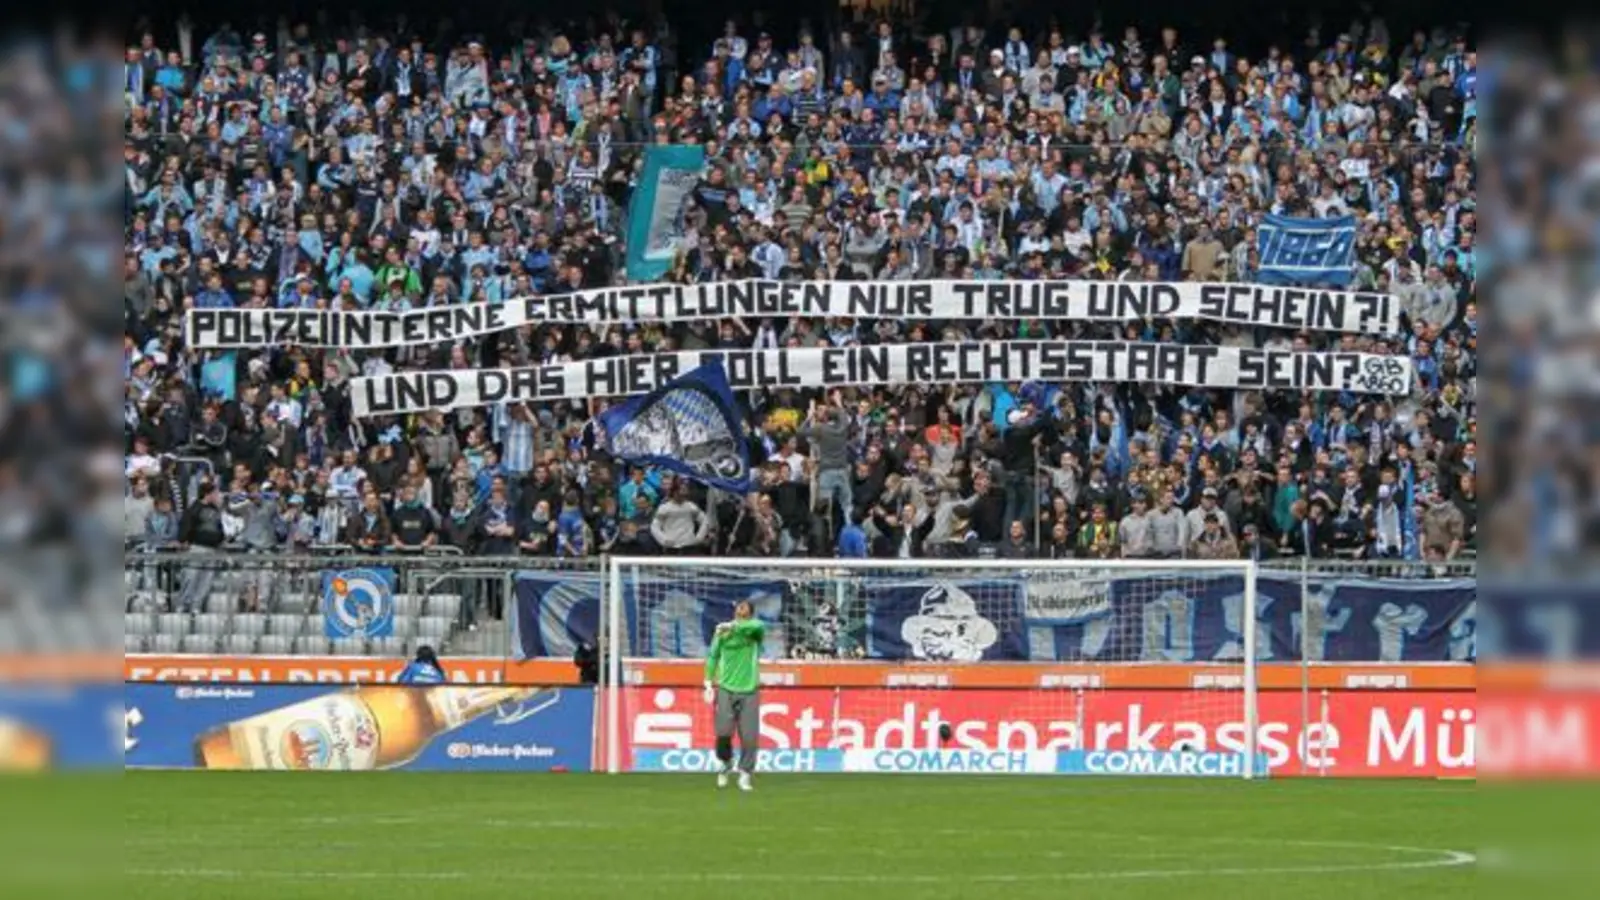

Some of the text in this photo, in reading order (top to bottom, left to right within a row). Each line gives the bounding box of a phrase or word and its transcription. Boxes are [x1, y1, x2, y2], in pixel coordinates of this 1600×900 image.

[192, 303, 505, 344] POLIZEIINTERNE
[524, 282, 831, 319] ERMITTLUNGEN
[848, 284, 933, 315] NUR
[953, 283, 1068, 316] TRUG
[1087, 284, 1180, 317] UND
[366, 342, 1360, 411] UND DAS HIER OLL EIN RECHTSSTAAT SEIN?
[1364, 357, 1405, 375] GB
[1356, 374, 1405, 392] 1860
[874, 750, 1028, 771] COMARCH
[1085, 751, 1240, 774] COMARCH
